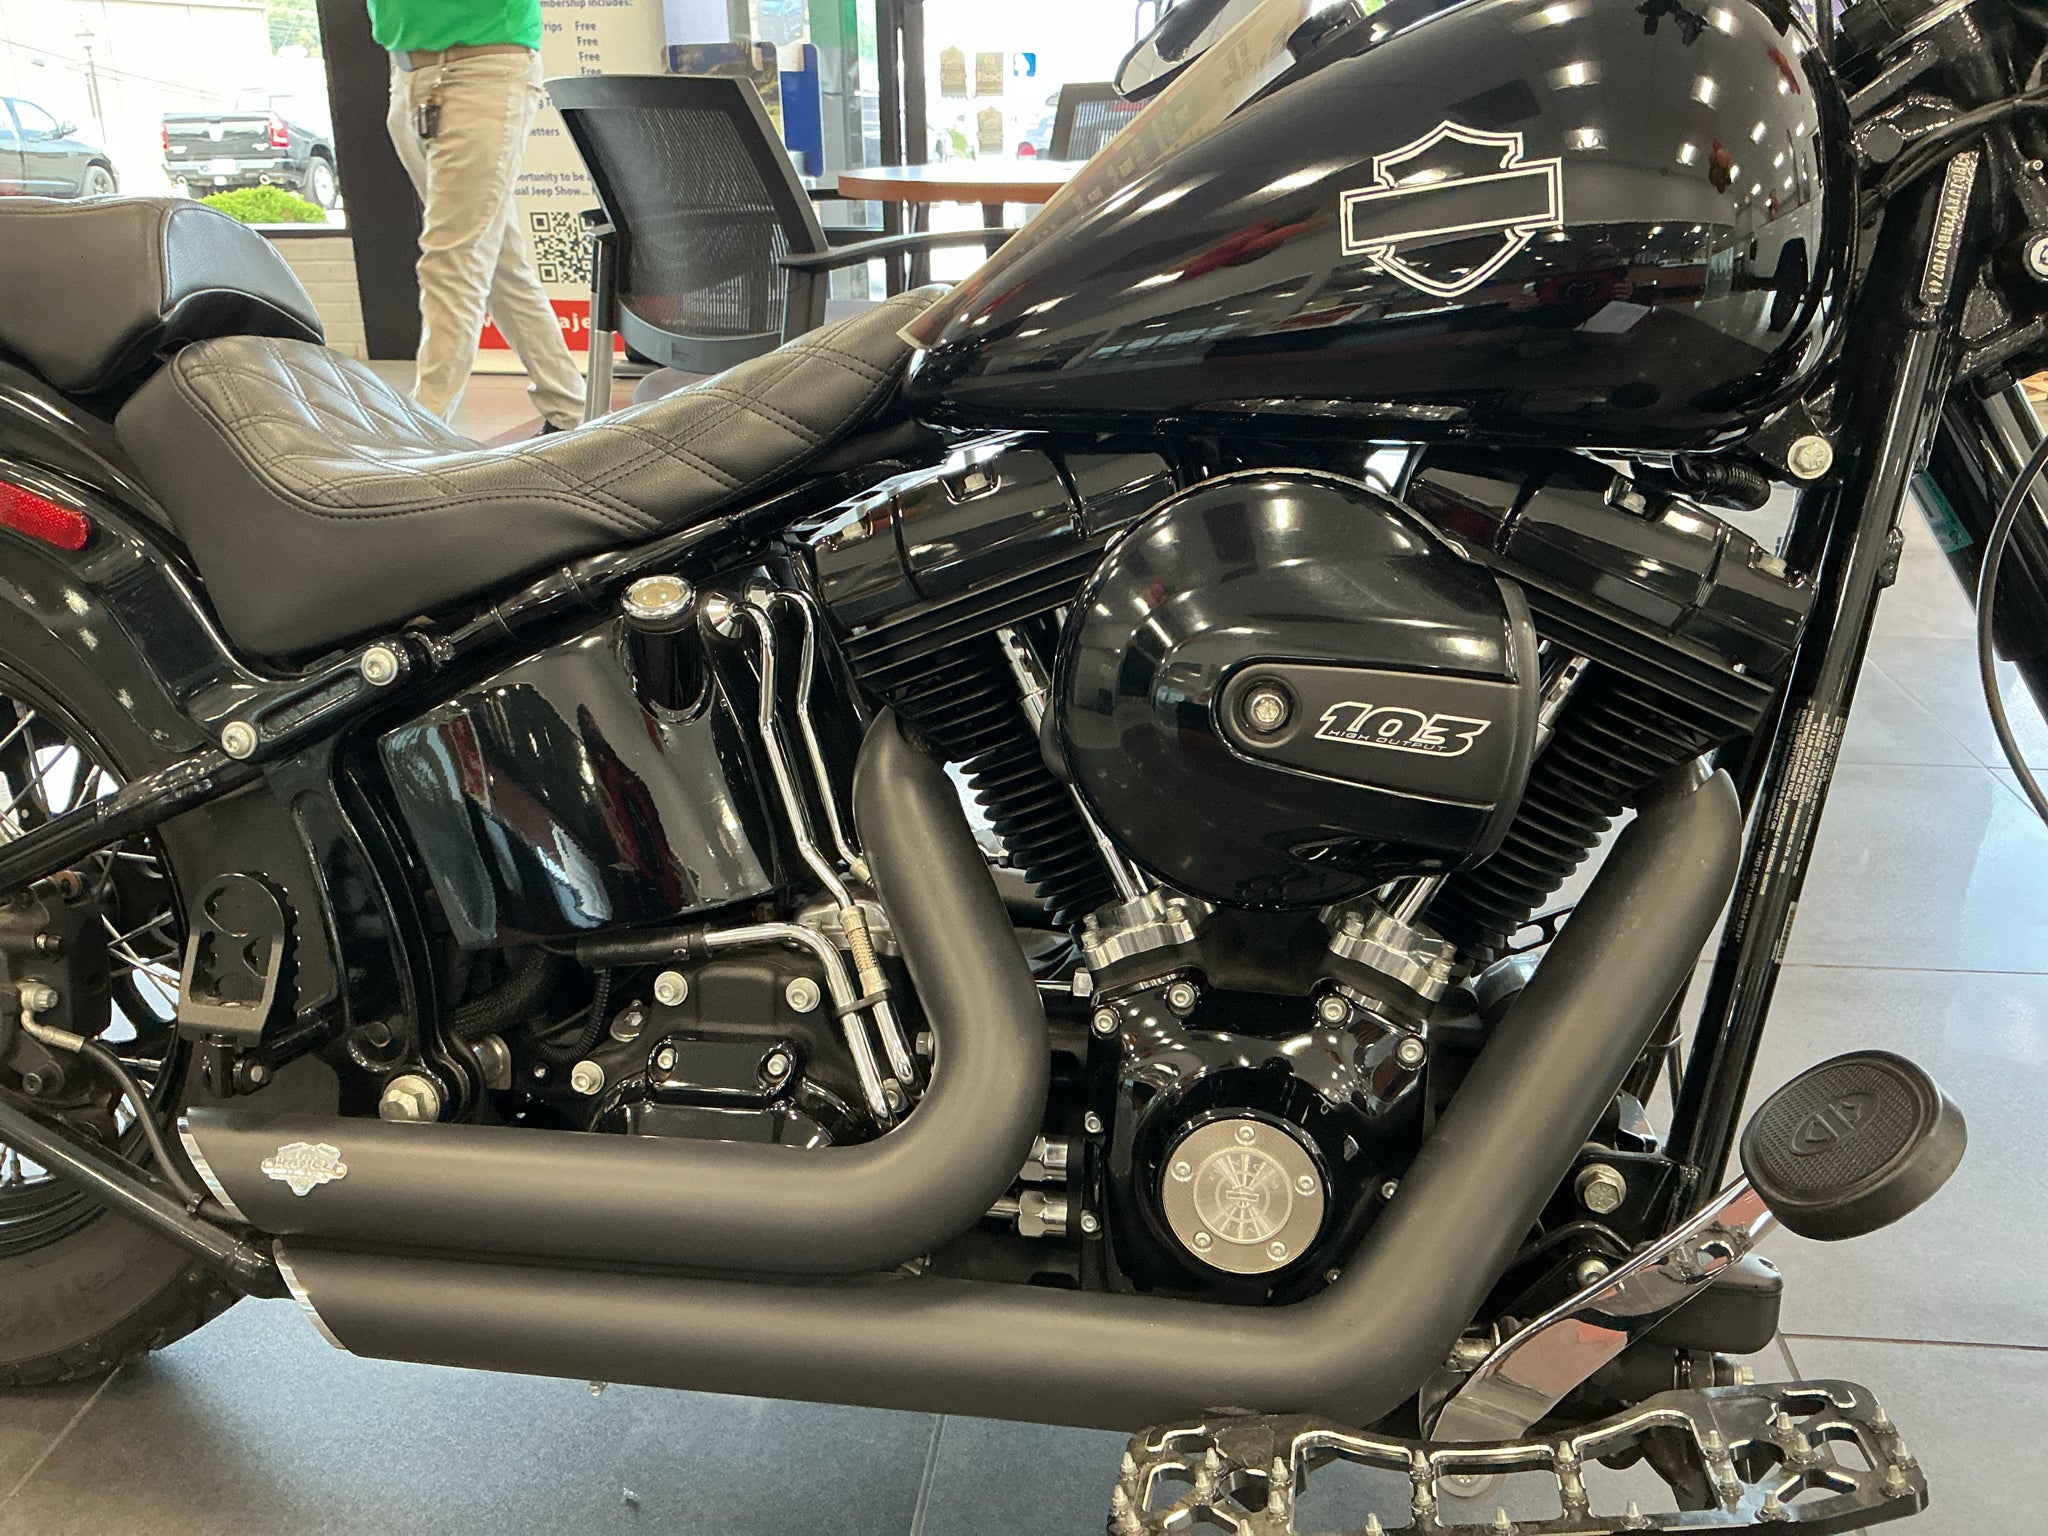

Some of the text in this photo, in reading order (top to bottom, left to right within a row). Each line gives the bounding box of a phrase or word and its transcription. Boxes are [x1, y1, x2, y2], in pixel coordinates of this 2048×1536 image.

[543, 21, 597, 33] rips Free
[577, 36, 599, 46] Free
[579, 51, 600, 61] Free
[581, 67, 602, 75] Free
[560, 173, 570, 181] to
[573, 172, 584, 181] be
[531, 187, 552, 197] Jeep
[1314, 701, 1492, 757] 103
[1328, 729, 1448, 752] HIGH OUTPUT
